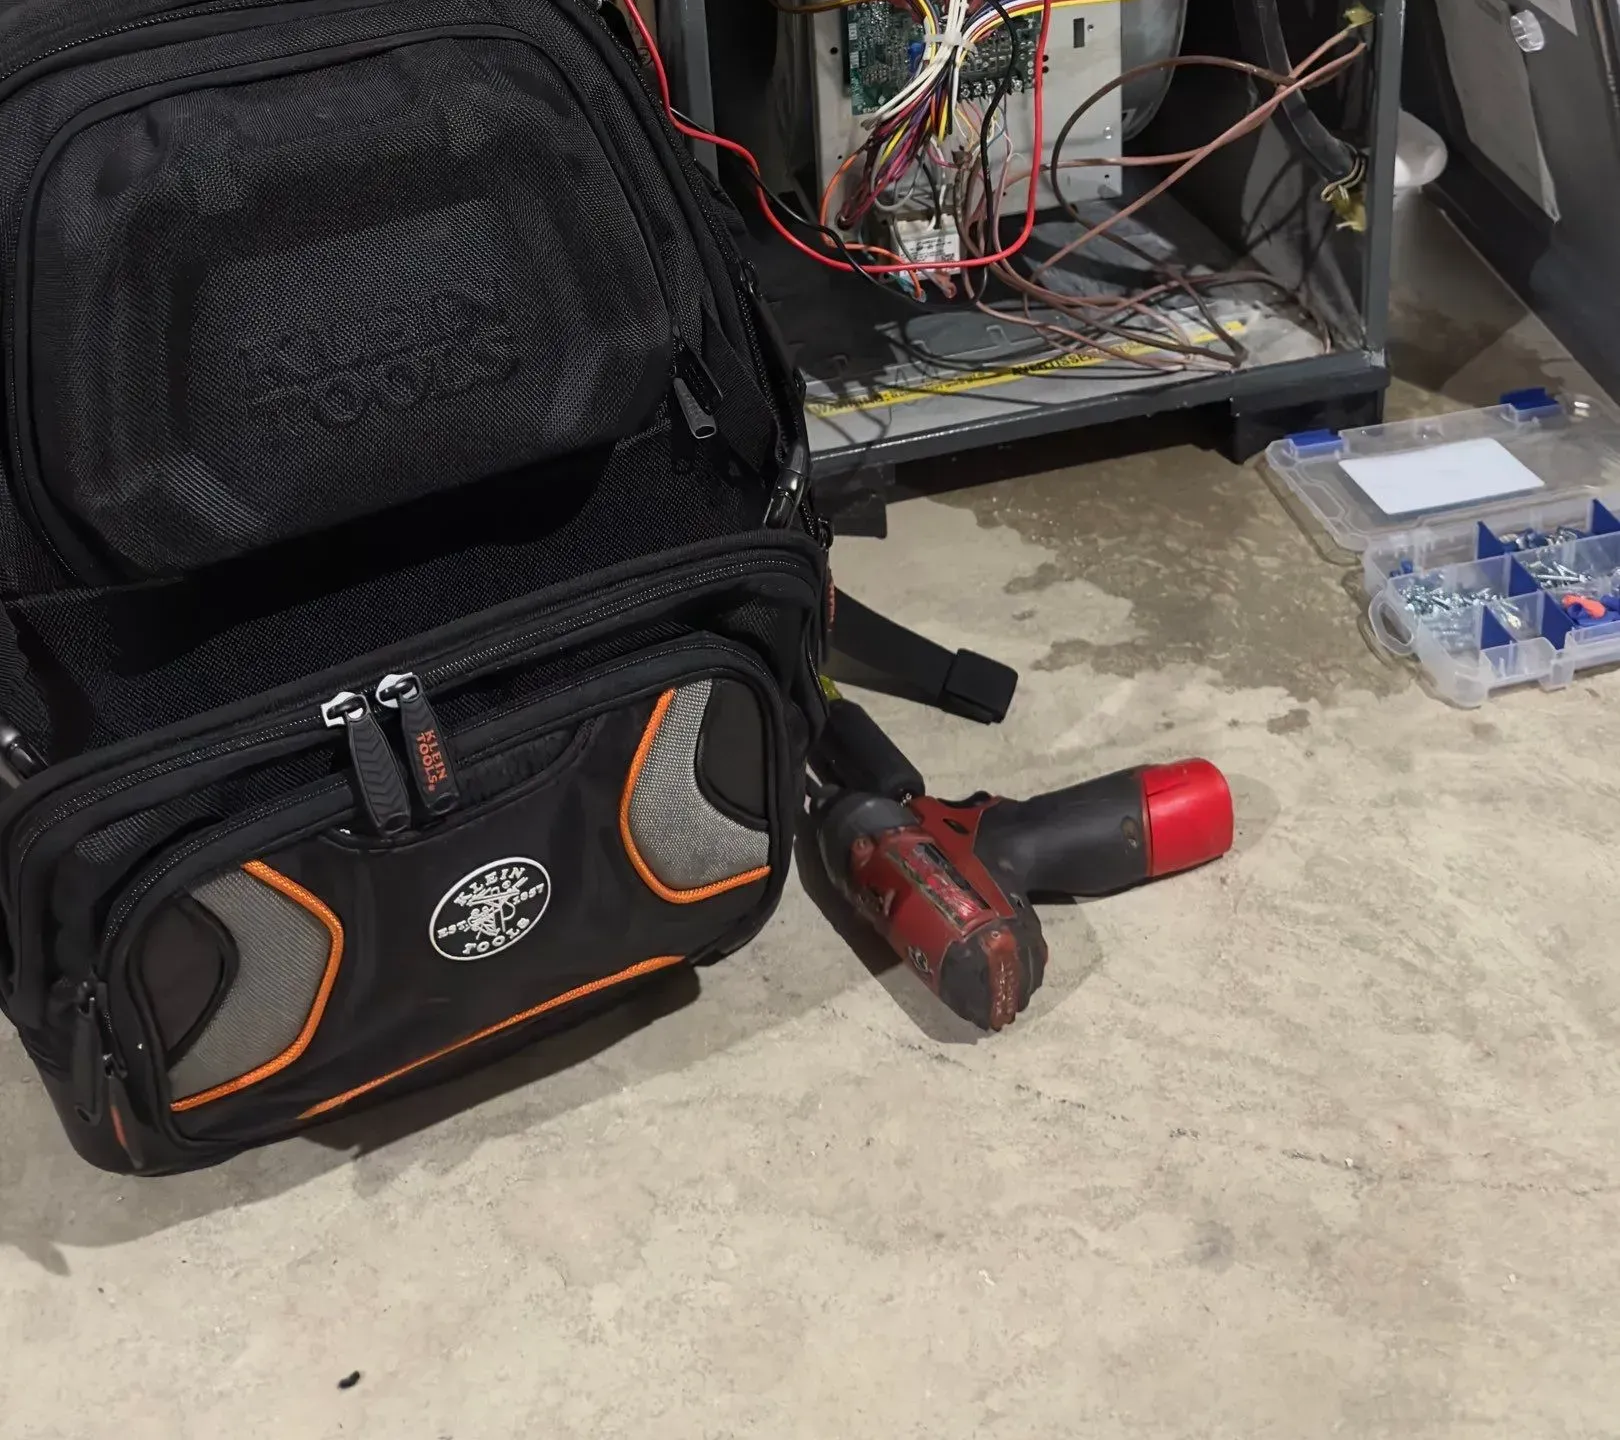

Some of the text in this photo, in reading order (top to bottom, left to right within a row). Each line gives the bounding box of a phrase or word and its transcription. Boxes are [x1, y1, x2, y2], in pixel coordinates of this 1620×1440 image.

[416, 732, 438, 784] TOOLS
[424, 729, 448, 780] KLEIN
[454, 866, 526, 907] KLEIN
[512, 882, 545, 906] 1857
[462, 917, 530, 955] TOOLS
